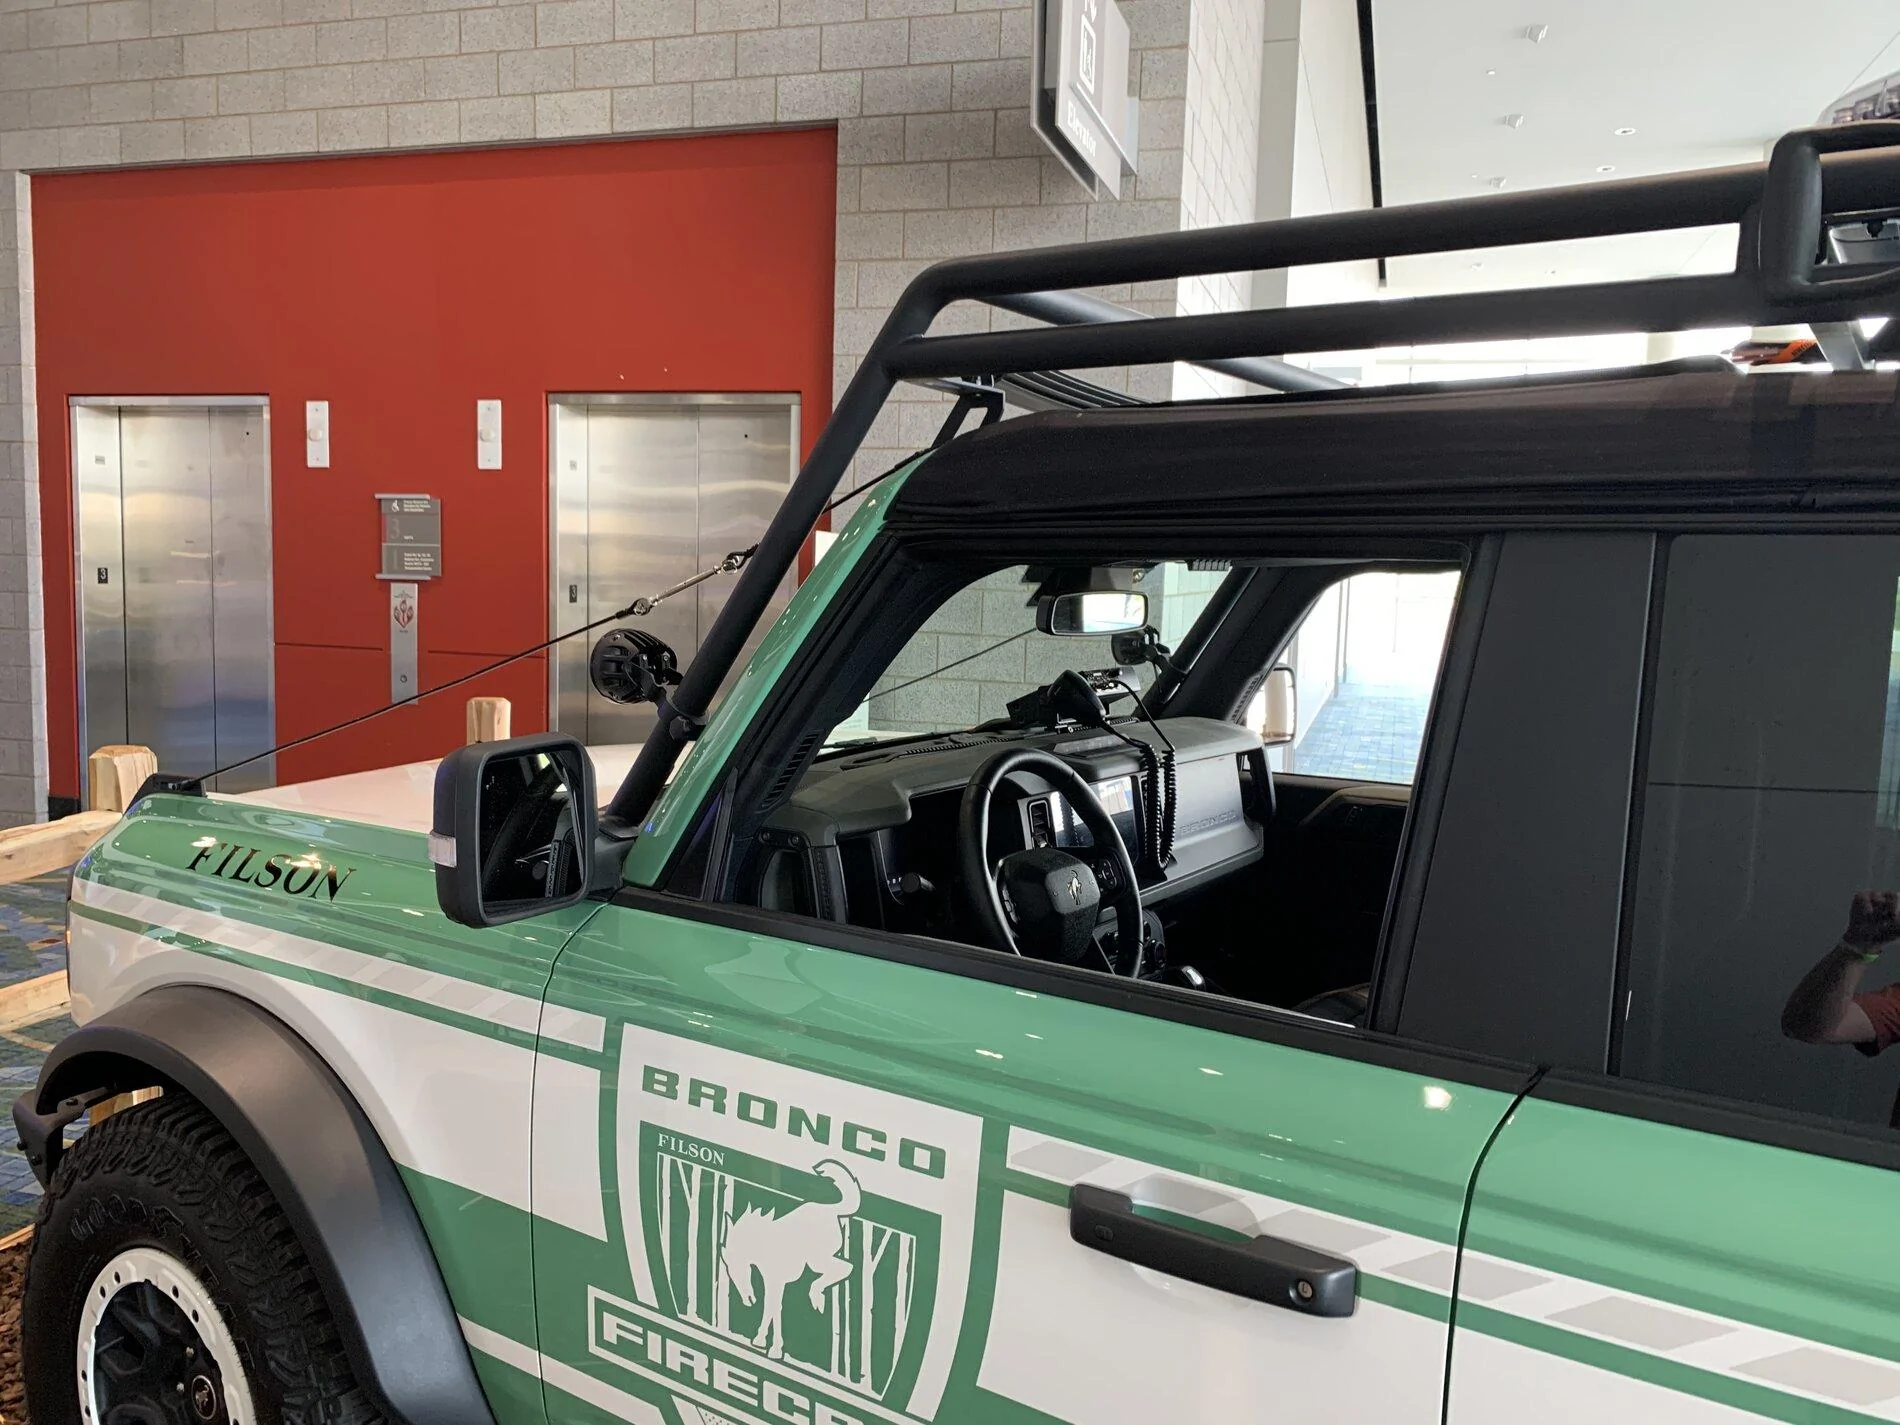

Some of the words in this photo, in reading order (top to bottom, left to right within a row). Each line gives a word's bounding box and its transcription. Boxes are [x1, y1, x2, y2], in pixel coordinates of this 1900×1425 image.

[1067, 100, 1096, 157] Elevator
[100, 568, 107, 580] 3
[185, 842, 357, 903] FILSON
[642, 1065, 945, 1179] BRONCO
[657, 1132, 726, 1166] FILSON
